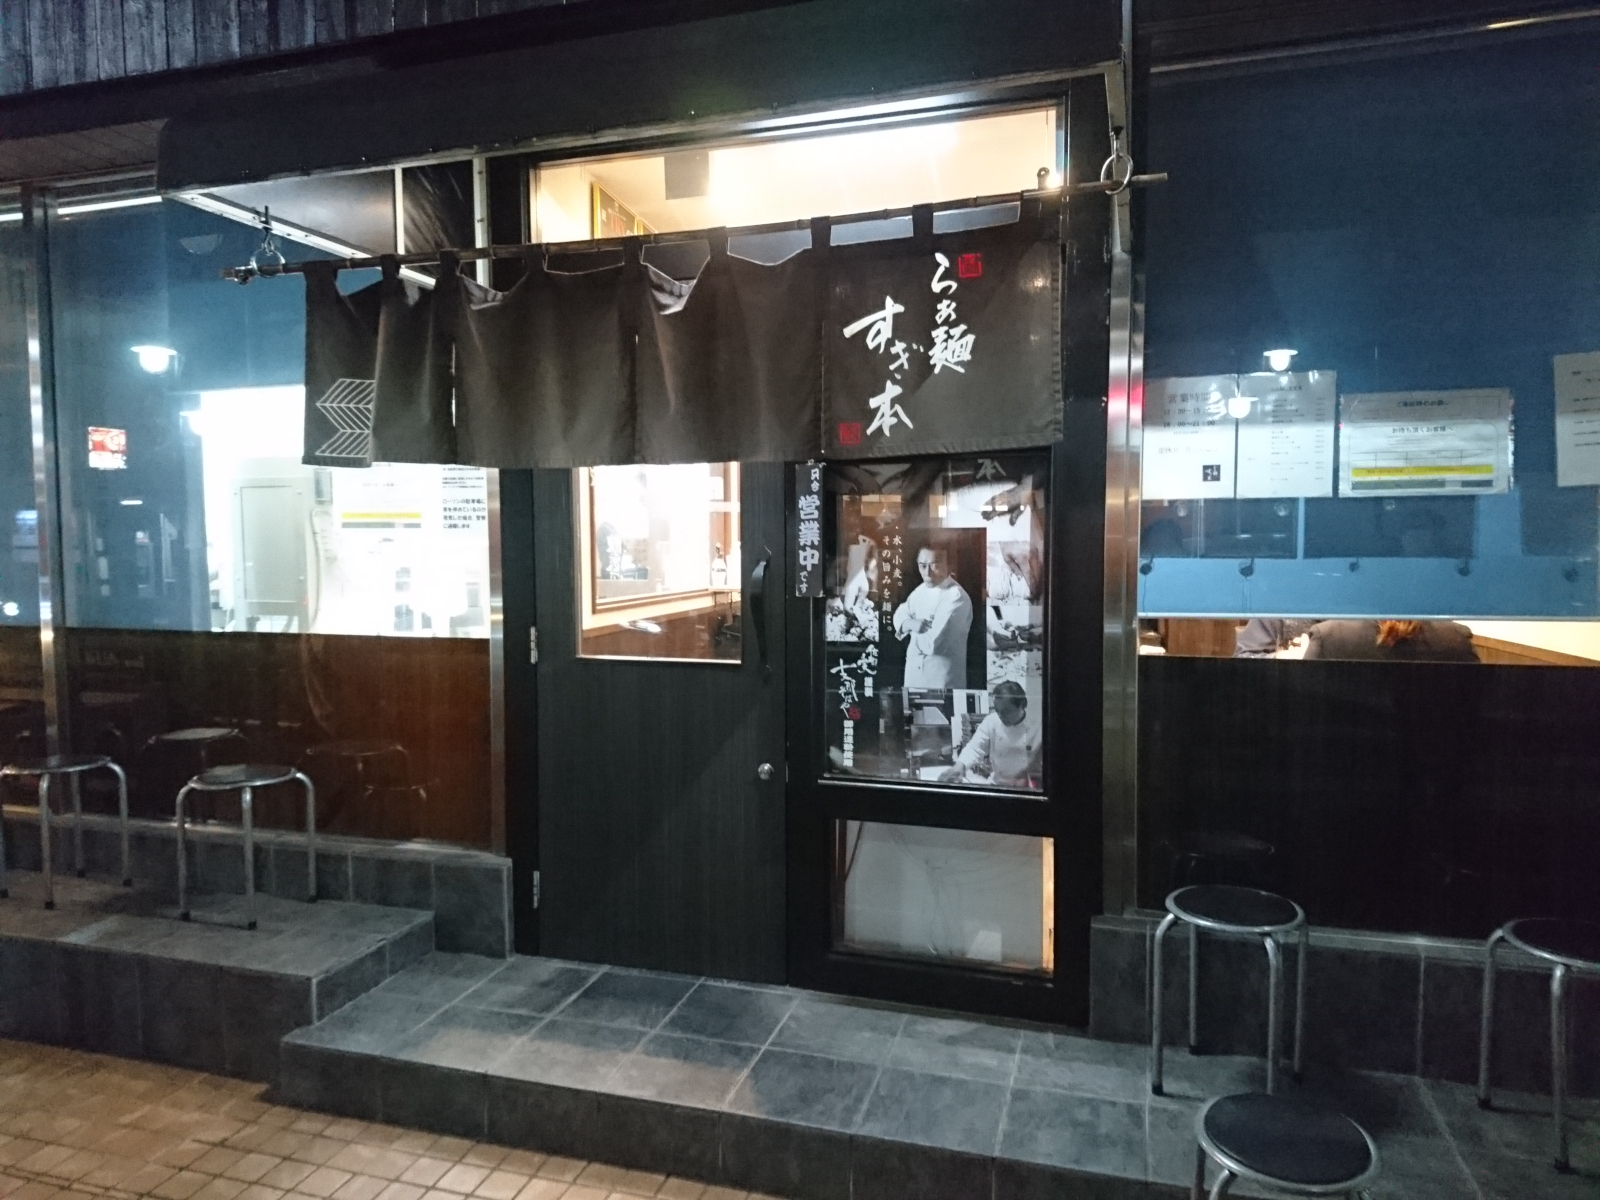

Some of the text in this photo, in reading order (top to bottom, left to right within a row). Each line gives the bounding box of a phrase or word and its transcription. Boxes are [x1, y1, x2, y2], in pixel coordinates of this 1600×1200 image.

[927, 252, 977, 375] らぁ麺
[842, 295, 924, 438] すぎ本
[810, 467, 820, 493] 只今
[798, 494, 821, 572] 営業中
[799, 570, 809, 594] です
